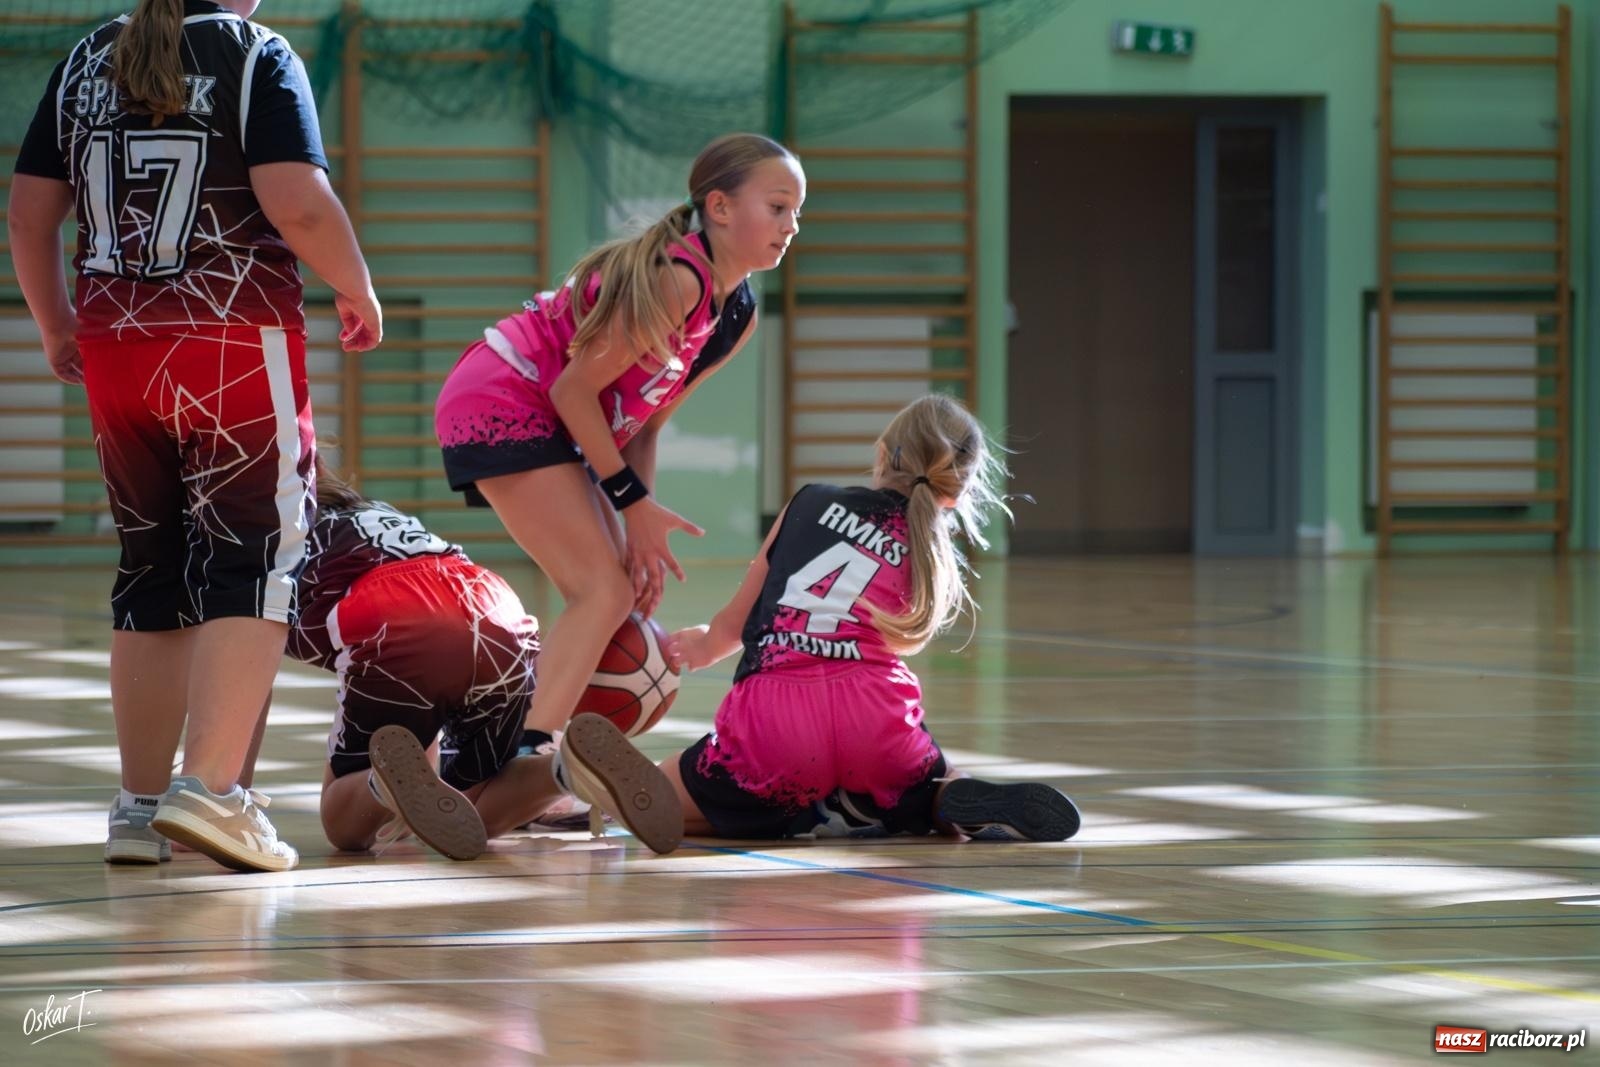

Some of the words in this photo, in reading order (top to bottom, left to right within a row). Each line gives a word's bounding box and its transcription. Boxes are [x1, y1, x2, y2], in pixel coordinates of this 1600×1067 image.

[80, 129, 208, 278] 17
[817, 502, 908, 567] RMKS
[776, 540, 882, 634] 4
